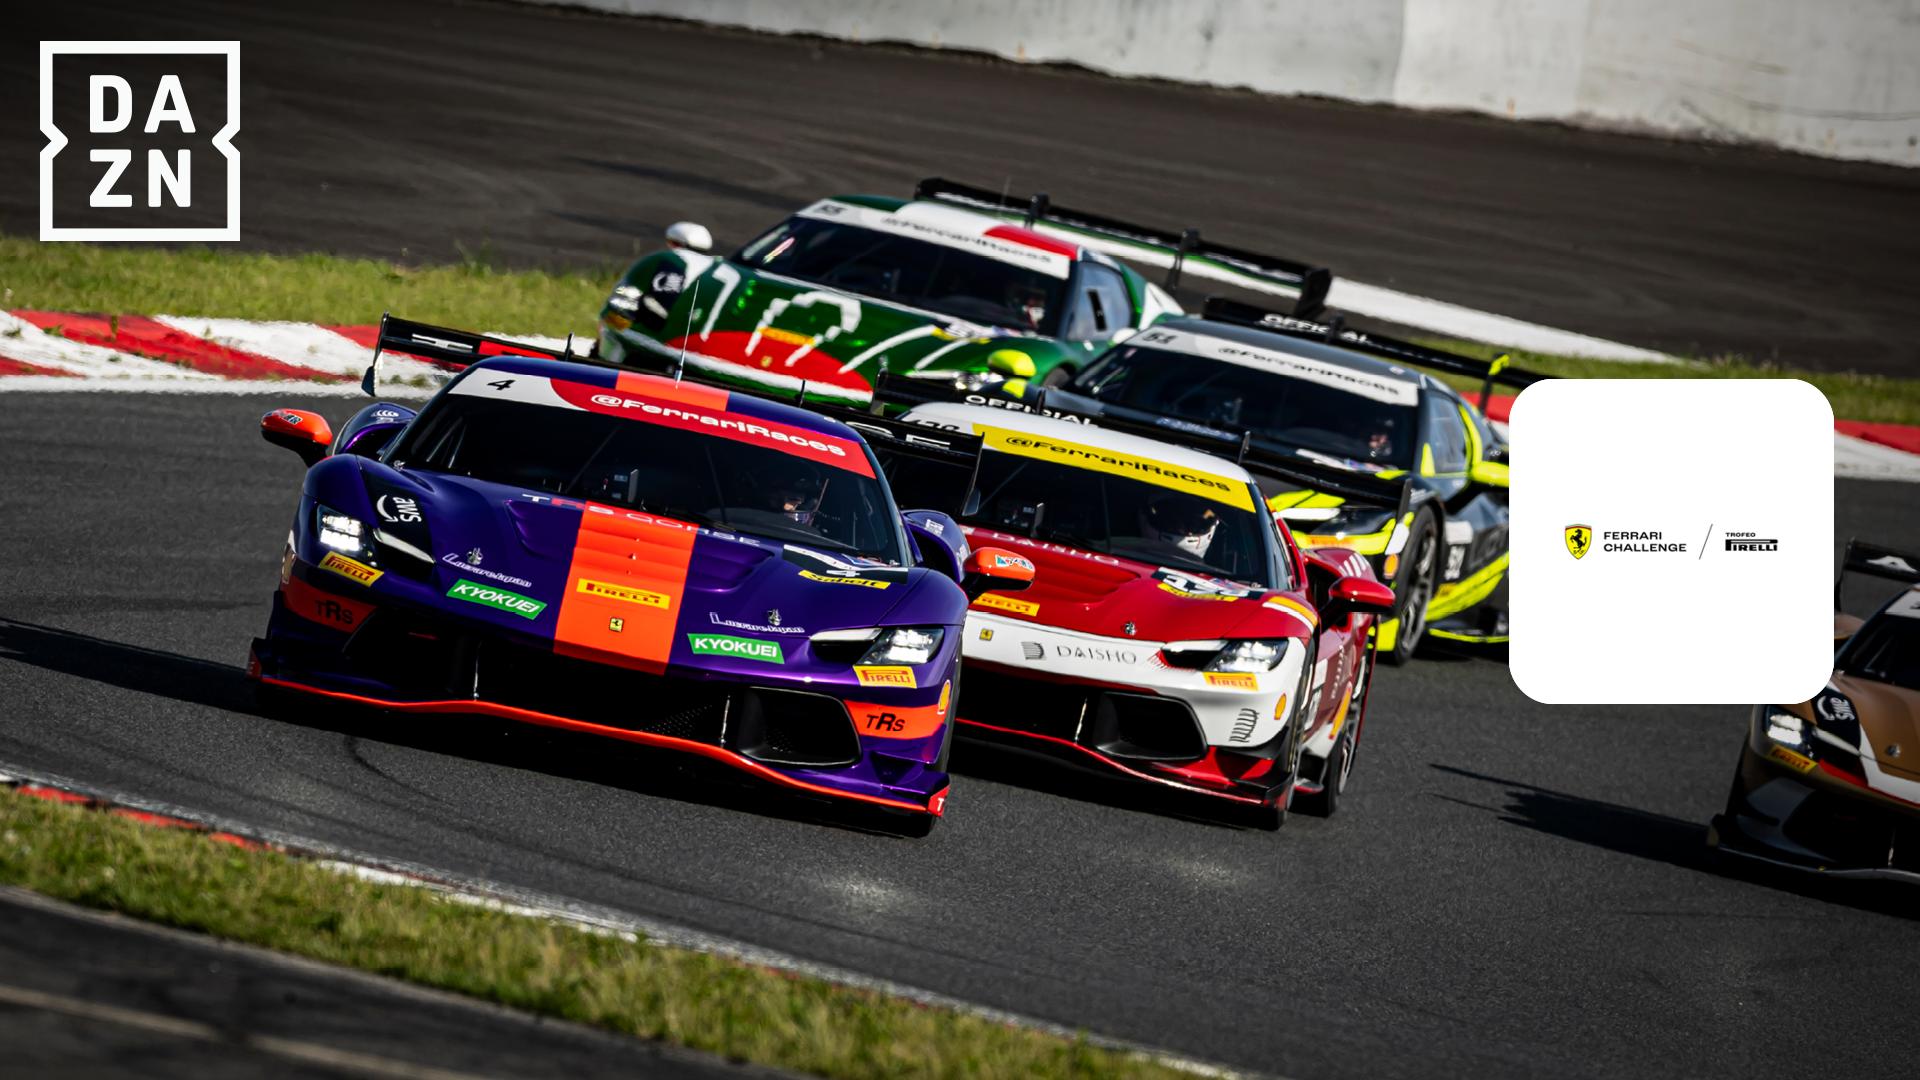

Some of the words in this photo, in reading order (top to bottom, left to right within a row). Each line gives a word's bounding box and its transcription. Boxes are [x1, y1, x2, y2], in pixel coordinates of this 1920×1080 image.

[487, 379, 516, 391] 4
[590, 393, 848, 459] @FerrariRaces
[1005, 436, 1231, 493] @FerrariRaces
[392, 496, 423, 523] aws
[325, 555, 375, 582] PIRELLI
[454, 583, 541, 613] KYOKUEI
[695, 637, 778, 658] KYOKUEI
[1056, 645, 1137, 665] DAISHO
[861, 669, 911, 684] PIRELLI
[1209, 675, 1255, 689] PIRELLI
